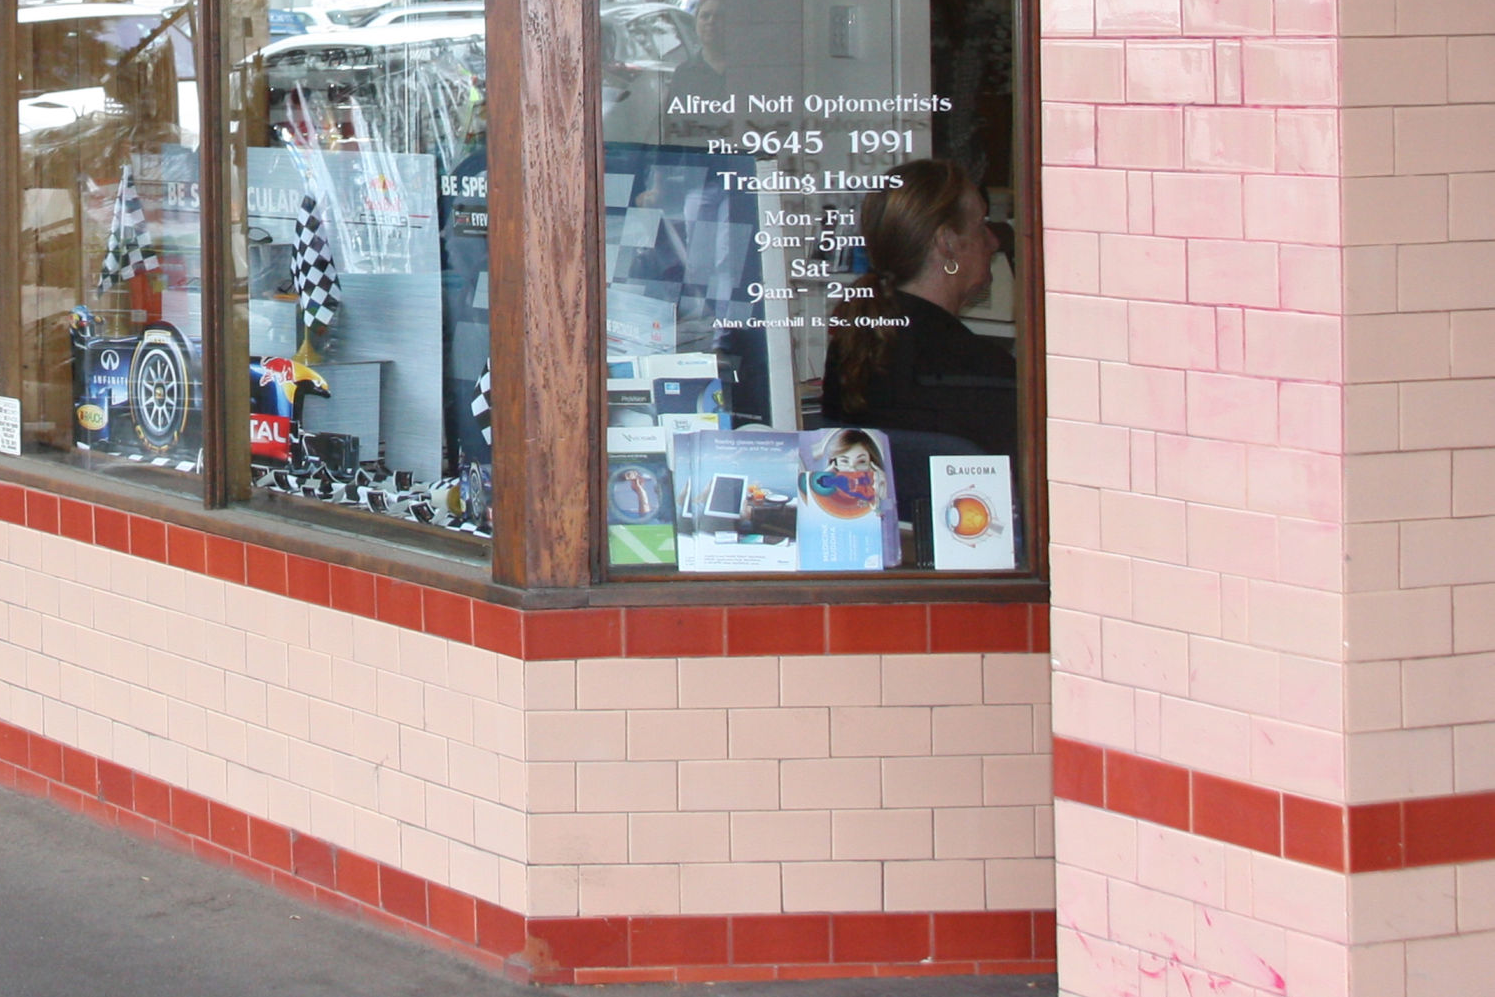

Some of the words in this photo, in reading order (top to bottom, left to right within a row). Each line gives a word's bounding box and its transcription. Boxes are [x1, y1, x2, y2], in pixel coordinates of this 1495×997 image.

[667, 94, 736, 114] Alfred
[748, 95, 794, 113] Nott
[804, 93, 952, 118] Optometrists
[707, 139, 738, 154] Ph:
[742, 130, 823, 154] 9645
[849, 130, 913, 154] 1991
[441, 175, 459, 197] BE
[461, 175, 488, 198] SPE
[717, 171, 816, 194] Trading
[824, 170, 904, 190] Hours
[791, 259, 830, 277] Sat
[827, 282, 874, 302] 2pm
[712, 317, 742, 329] Alan
[746, 316, 804, 328] Greenhill
[250, 420, 287, 443] TAL
